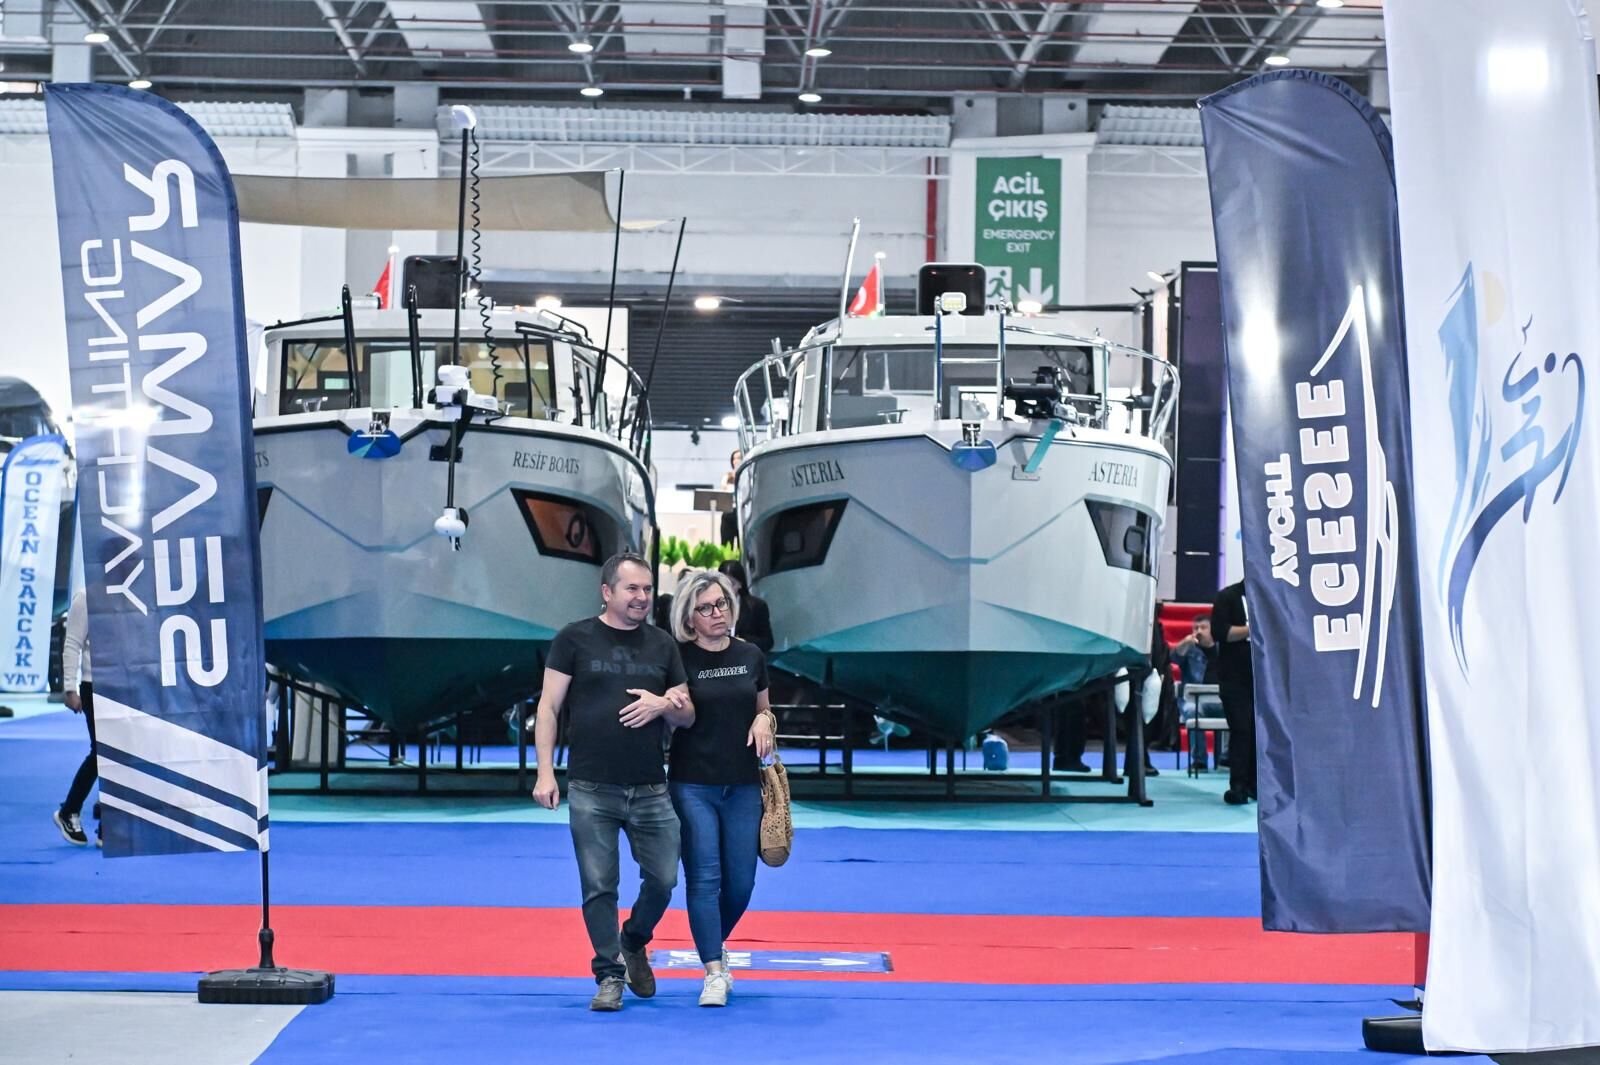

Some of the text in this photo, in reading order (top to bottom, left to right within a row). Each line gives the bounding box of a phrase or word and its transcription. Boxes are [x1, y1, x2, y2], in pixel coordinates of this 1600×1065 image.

[993, 171, 1044, 194] ACİL
[988, 200, 1048, 222] ÇIKIŞ
[983, 229, 1055, 240] EMERGENCY
[1006, 242, 1031, 253] EXIT
[513, 451, 580, 474] RESİF BOATS
[791, 460, 844, 488] ASTERIA
[1088, 461, 1138, 488] ASTERIA
[15, 471, 42, 667] OCEAN SANCAK
[4, 672, 39, 687] YAT
[698, 665, 748, 679] HUMMEL
